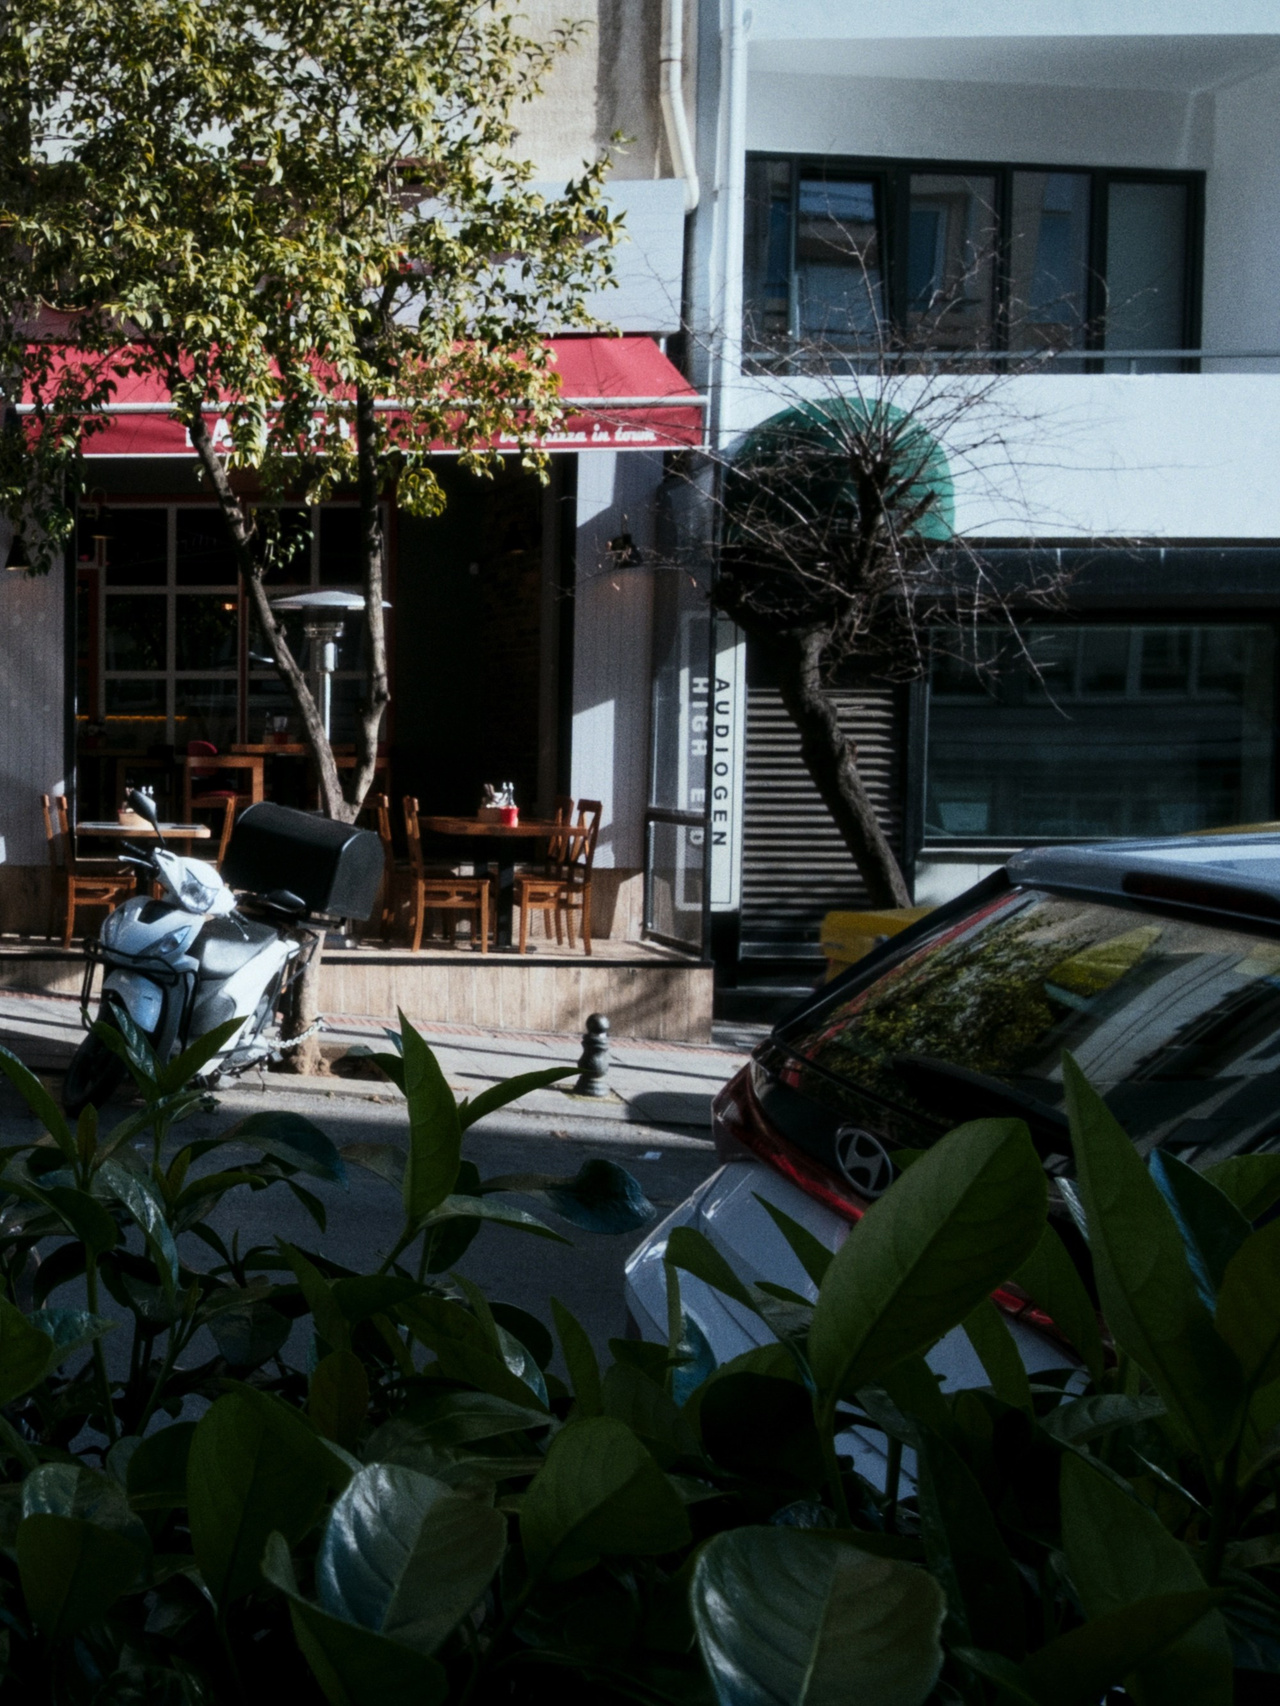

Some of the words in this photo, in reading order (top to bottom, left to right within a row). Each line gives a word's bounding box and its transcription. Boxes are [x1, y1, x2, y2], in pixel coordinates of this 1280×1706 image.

[591, 423, 610, 442] in
[615, 427, 657, 442] town
[691, 677, 709, 756] HIGH
[712, 678, 731, 846] AUDIOGEN
[689, 788, 706, 845] ED
